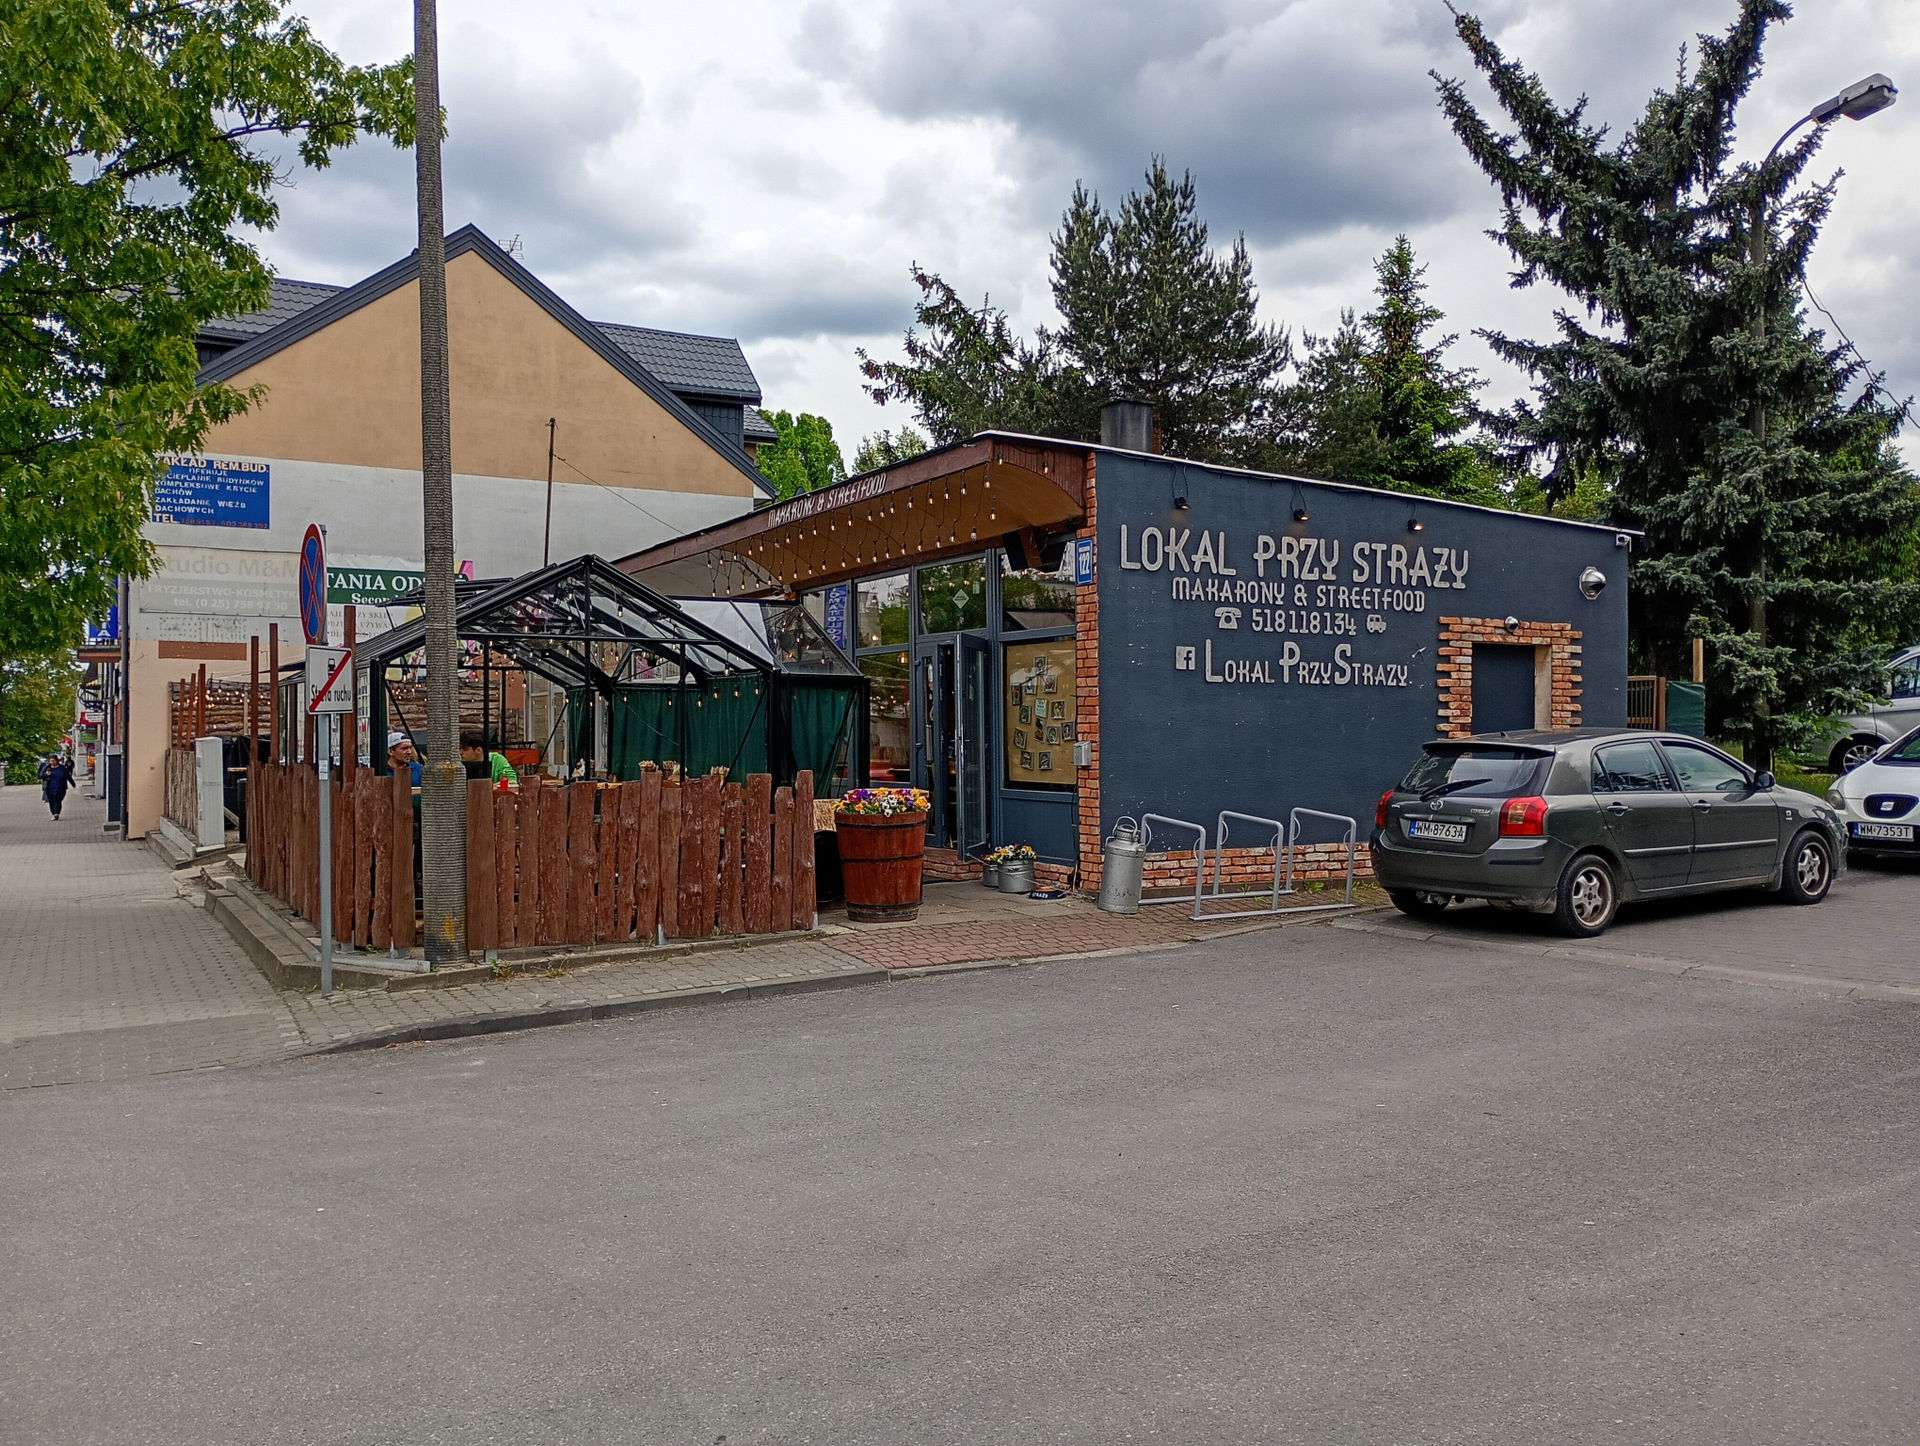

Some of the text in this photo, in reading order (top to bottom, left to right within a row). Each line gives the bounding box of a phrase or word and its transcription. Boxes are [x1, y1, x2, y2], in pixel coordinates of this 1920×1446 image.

[226, 485, 257, 493] KRYCIE
[768, 498, 815, 529] MAKARONY
[827, 472, 887, 508] STREETFOOD
[155, 505, 214, 514] DACHOWYCH
[165, 553, 230, 575] tudio
[1119, 523, 1237, 577] LOKAL
[1252, 534, 1340, 582] PRZY
[1172, 577, 1426, 613] MAKARONY & STREETFOOD
